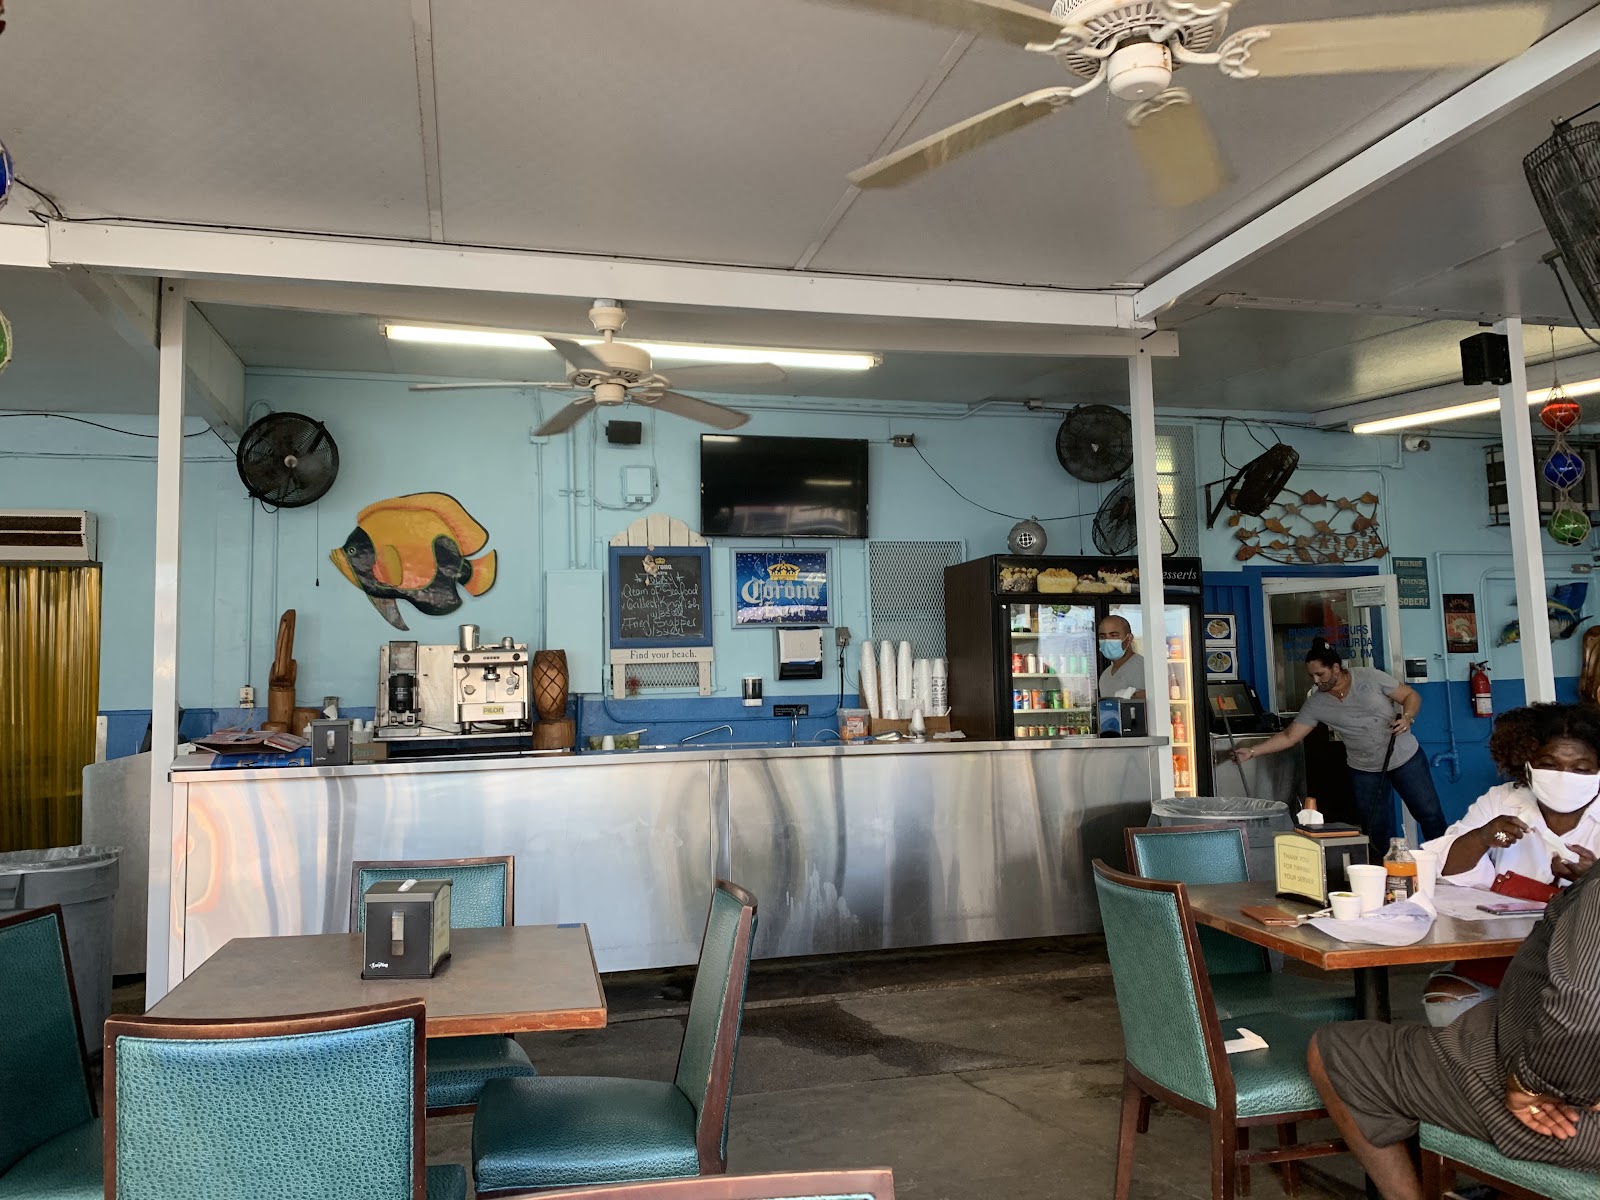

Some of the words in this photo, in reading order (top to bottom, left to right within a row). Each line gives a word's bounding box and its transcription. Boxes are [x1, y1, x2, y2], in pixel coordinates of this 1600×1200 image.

[1163, 568, 1197, 580] esserts
[741, 576, 820, 606] Corona
[1399, 597, 1428, 606] SOBER!
[763, 601, 806, 617] Extra
[630, 650, 649, 659] Find
[652, 652, 669, 661] your
[672, 649, 697, 658] beach.
[1284, 873, 1296, 881] YOUR
[1298, 876, 1314, 885] SERVER
